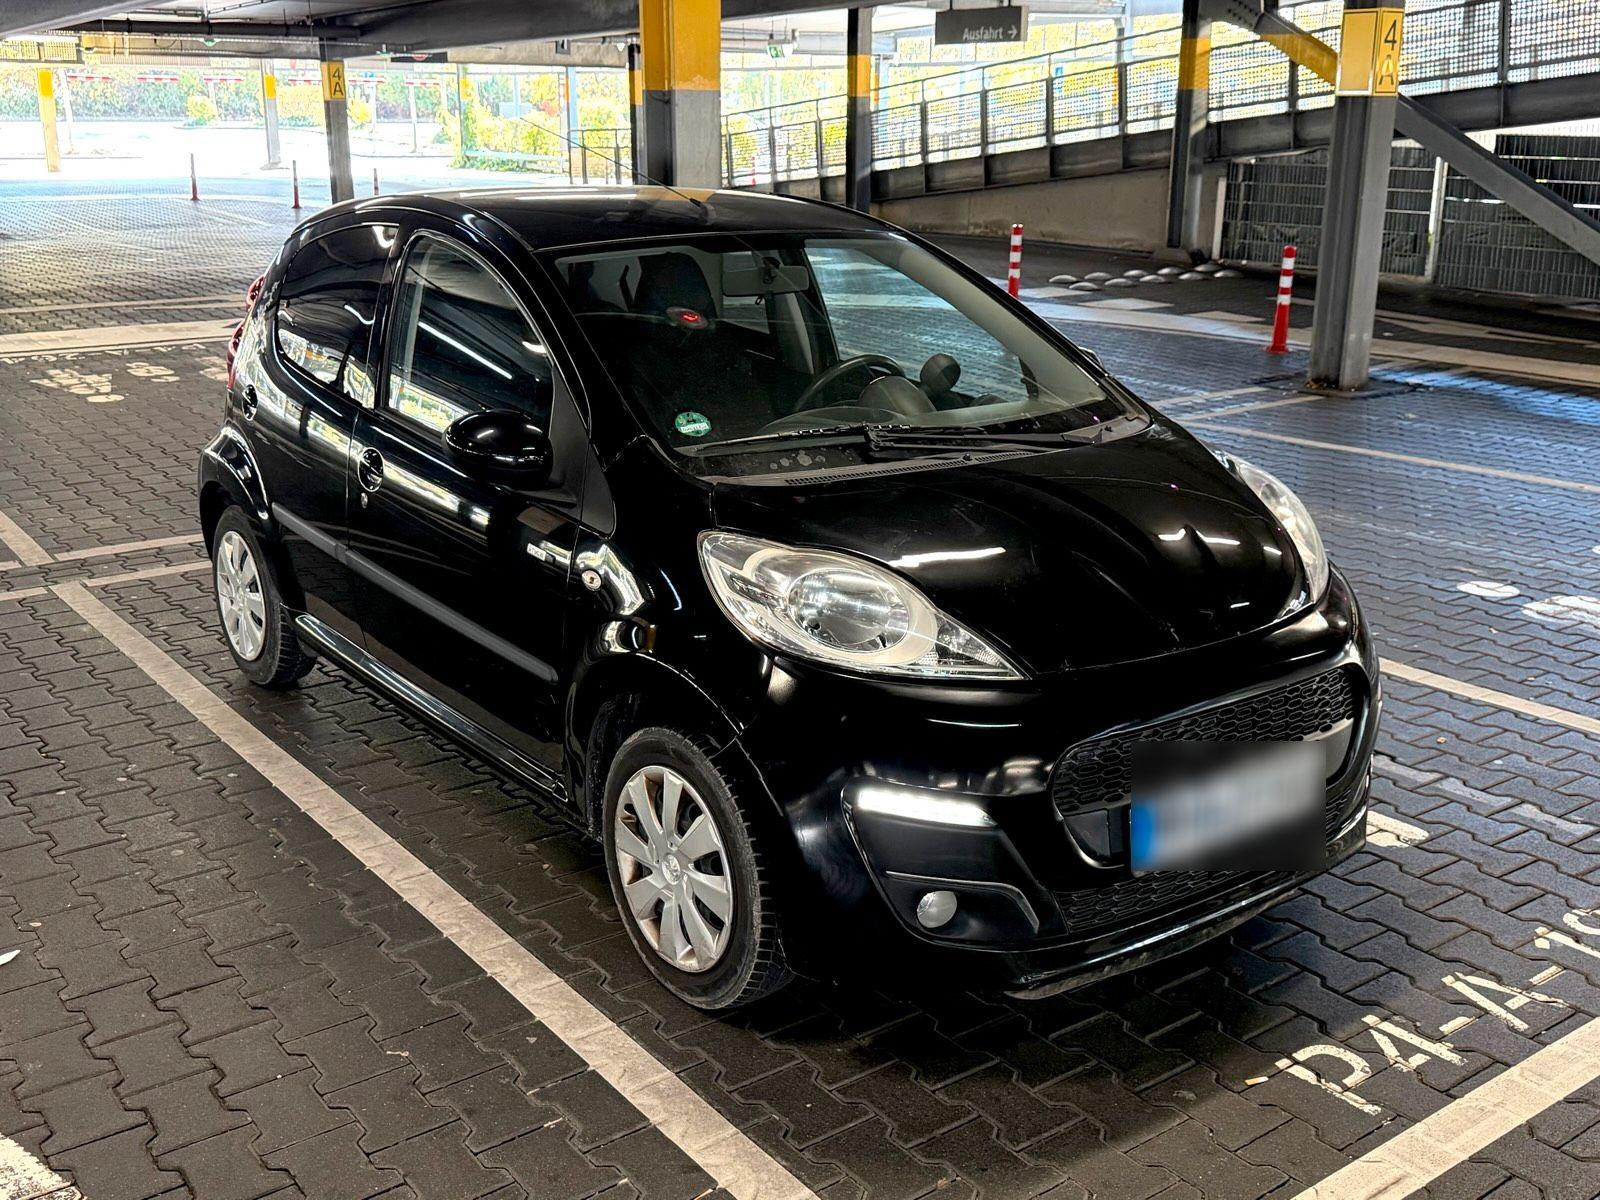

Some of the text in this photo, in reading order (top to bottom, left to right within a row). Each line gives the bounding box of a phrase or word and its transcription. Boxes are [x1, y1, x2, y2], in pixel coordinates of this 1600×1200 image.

[962, 26, 1004, 41] Ausfahrt
[1383, 19, 1398, 51] 4
[332, 66, 342, 81] 4
[1378, 54, 1395, 86] A
[333, 81, 344, 96] A
